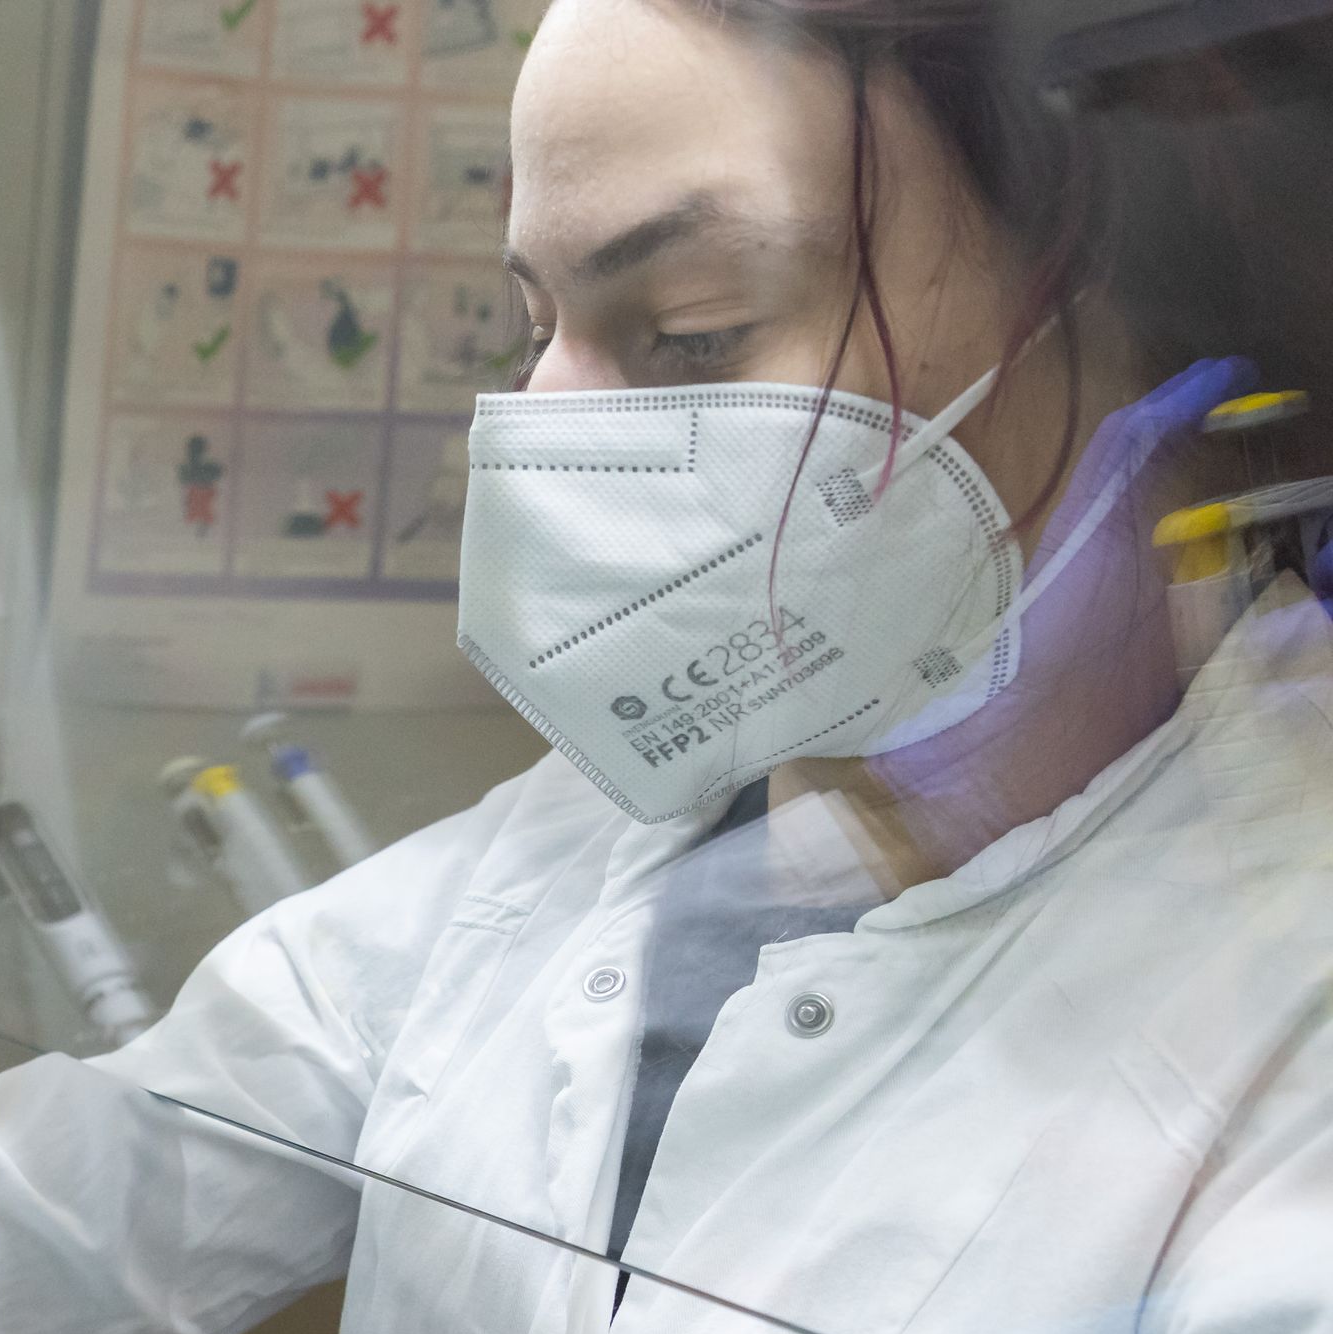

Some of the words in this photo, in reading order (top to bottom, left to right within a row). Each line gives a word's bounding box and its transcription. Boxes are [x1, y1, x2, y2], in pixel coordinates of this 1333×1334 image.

[630, 730, 658, 752] EN
[642, 725, 711, 768] FFP2
[708, 702, 751, 732] NR
